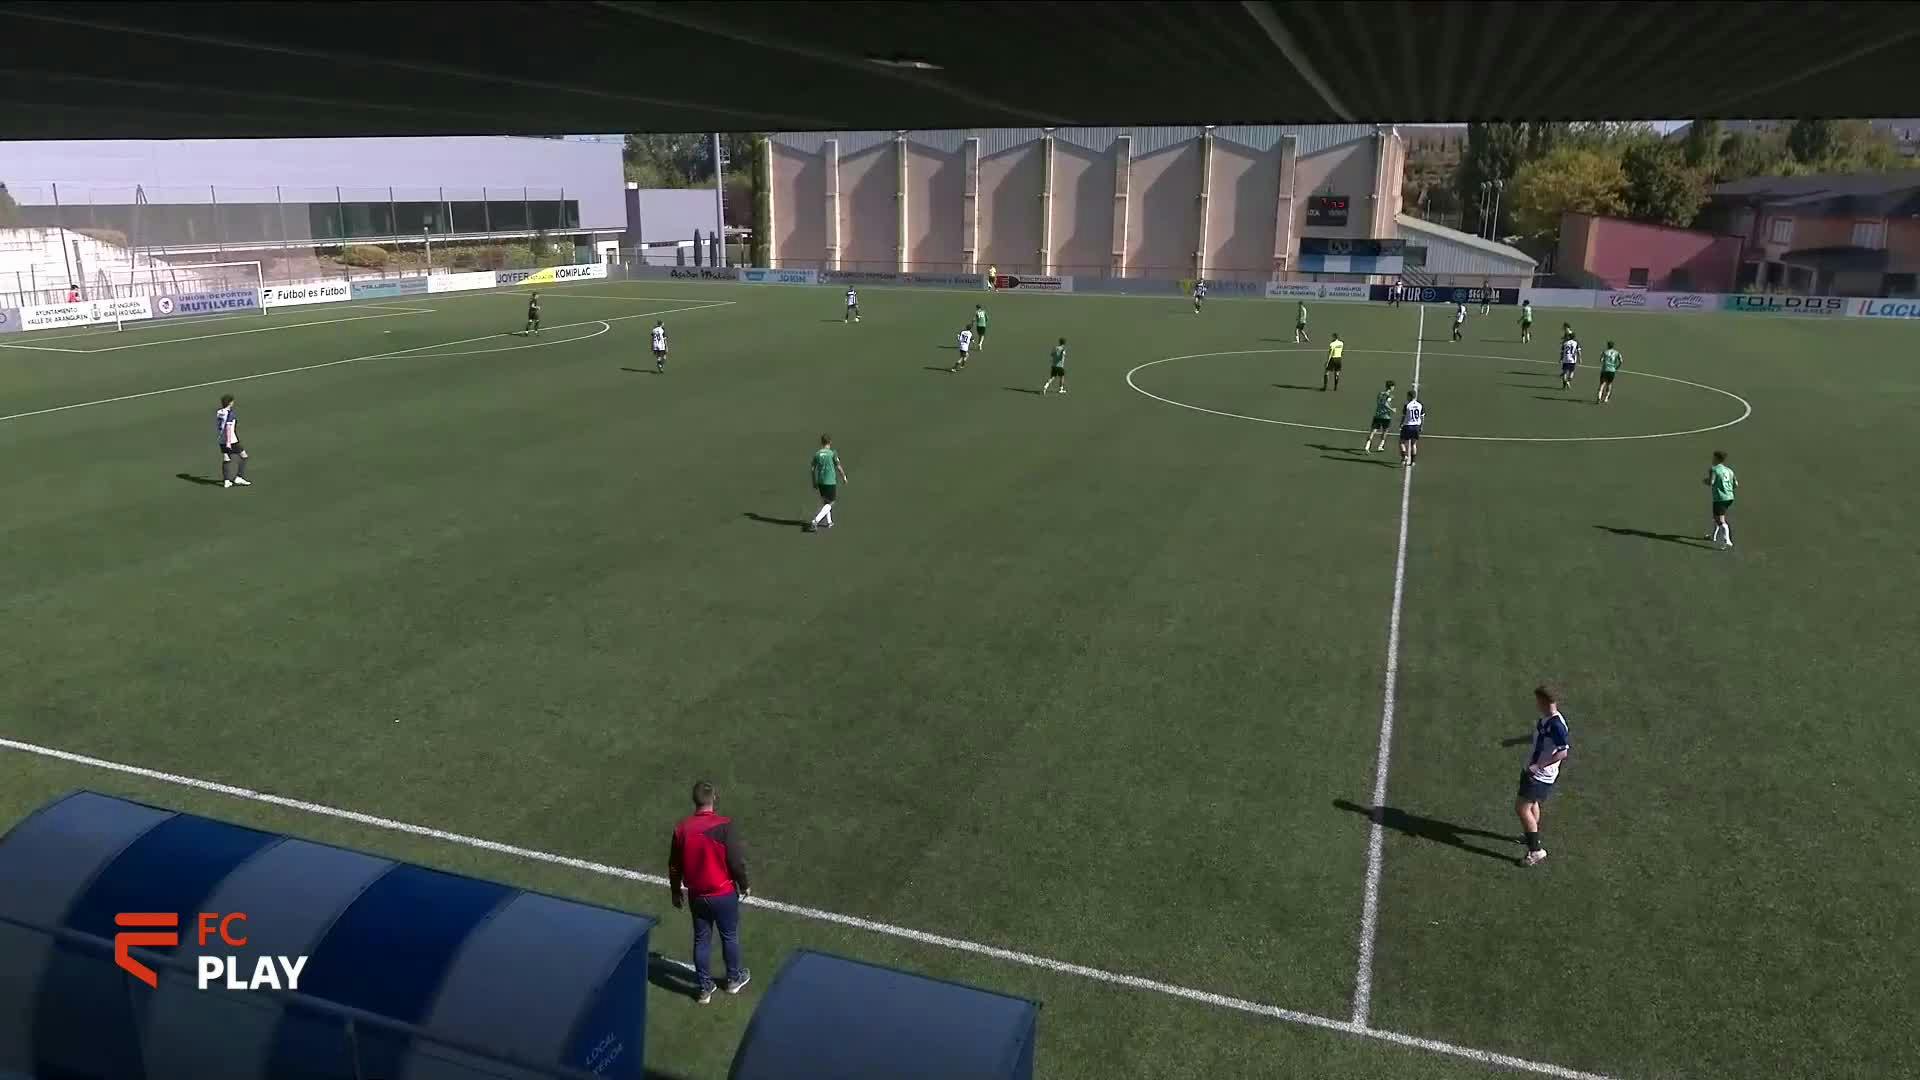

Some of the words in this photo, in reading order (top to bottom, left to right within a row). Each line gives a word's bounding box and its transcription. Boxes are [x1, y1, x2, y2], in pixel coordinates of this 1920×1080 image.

[555, 267, 591, 279] KOMIPLAC
[308, 289, 319, 297] es
[180, 298, 254, 312] MUTILVERA
[1735, 296, 1841, 310] TOLDOS
